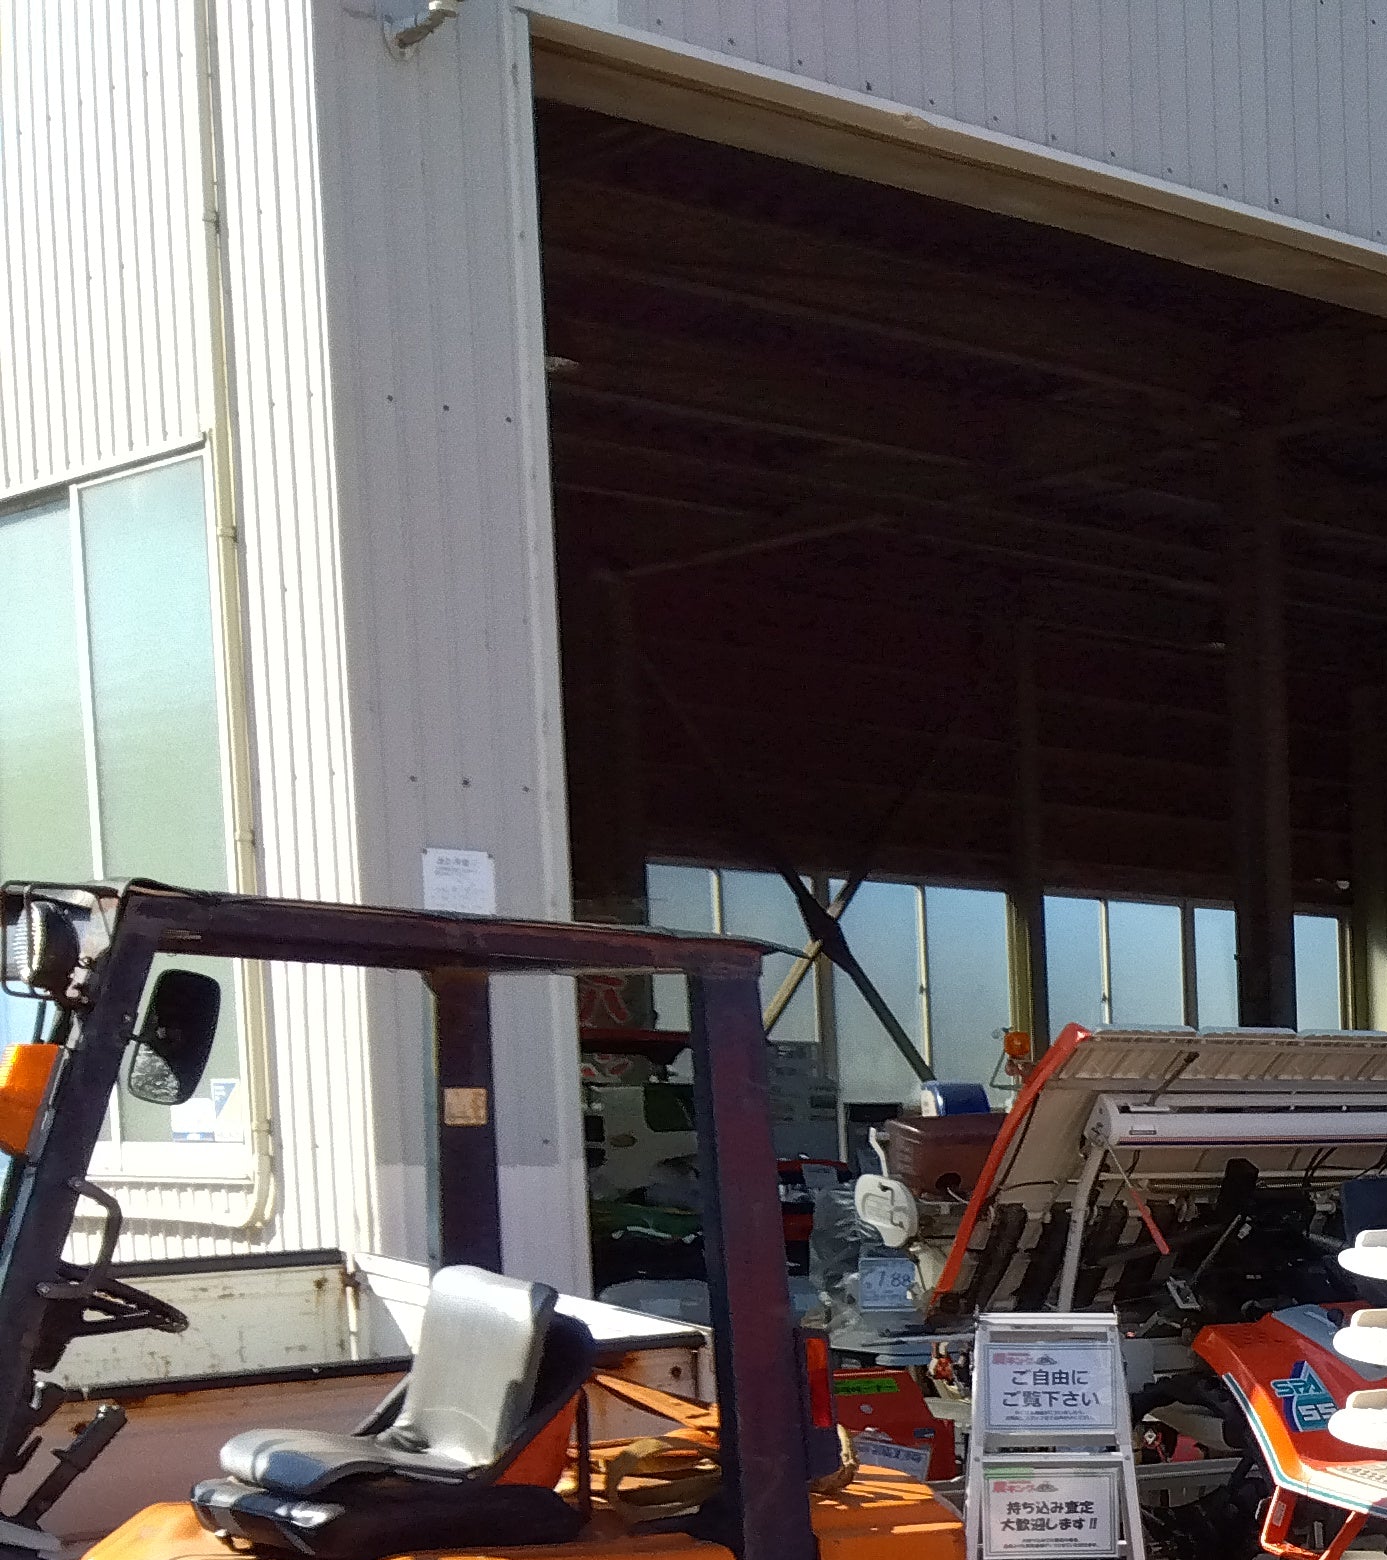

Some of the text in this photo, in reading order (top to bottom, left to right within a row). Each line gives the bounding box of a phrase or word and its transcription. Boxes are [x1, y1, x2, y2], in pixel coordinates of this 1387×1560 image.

[1012, 1369, 1088, 1386] ご自由に
[1003, 1391, 1099, 1407] ご覧下さい
[1298, 1402, 1338, 1421] 55
[1007, 1501, 1094, 1515] 持ち込み査定
